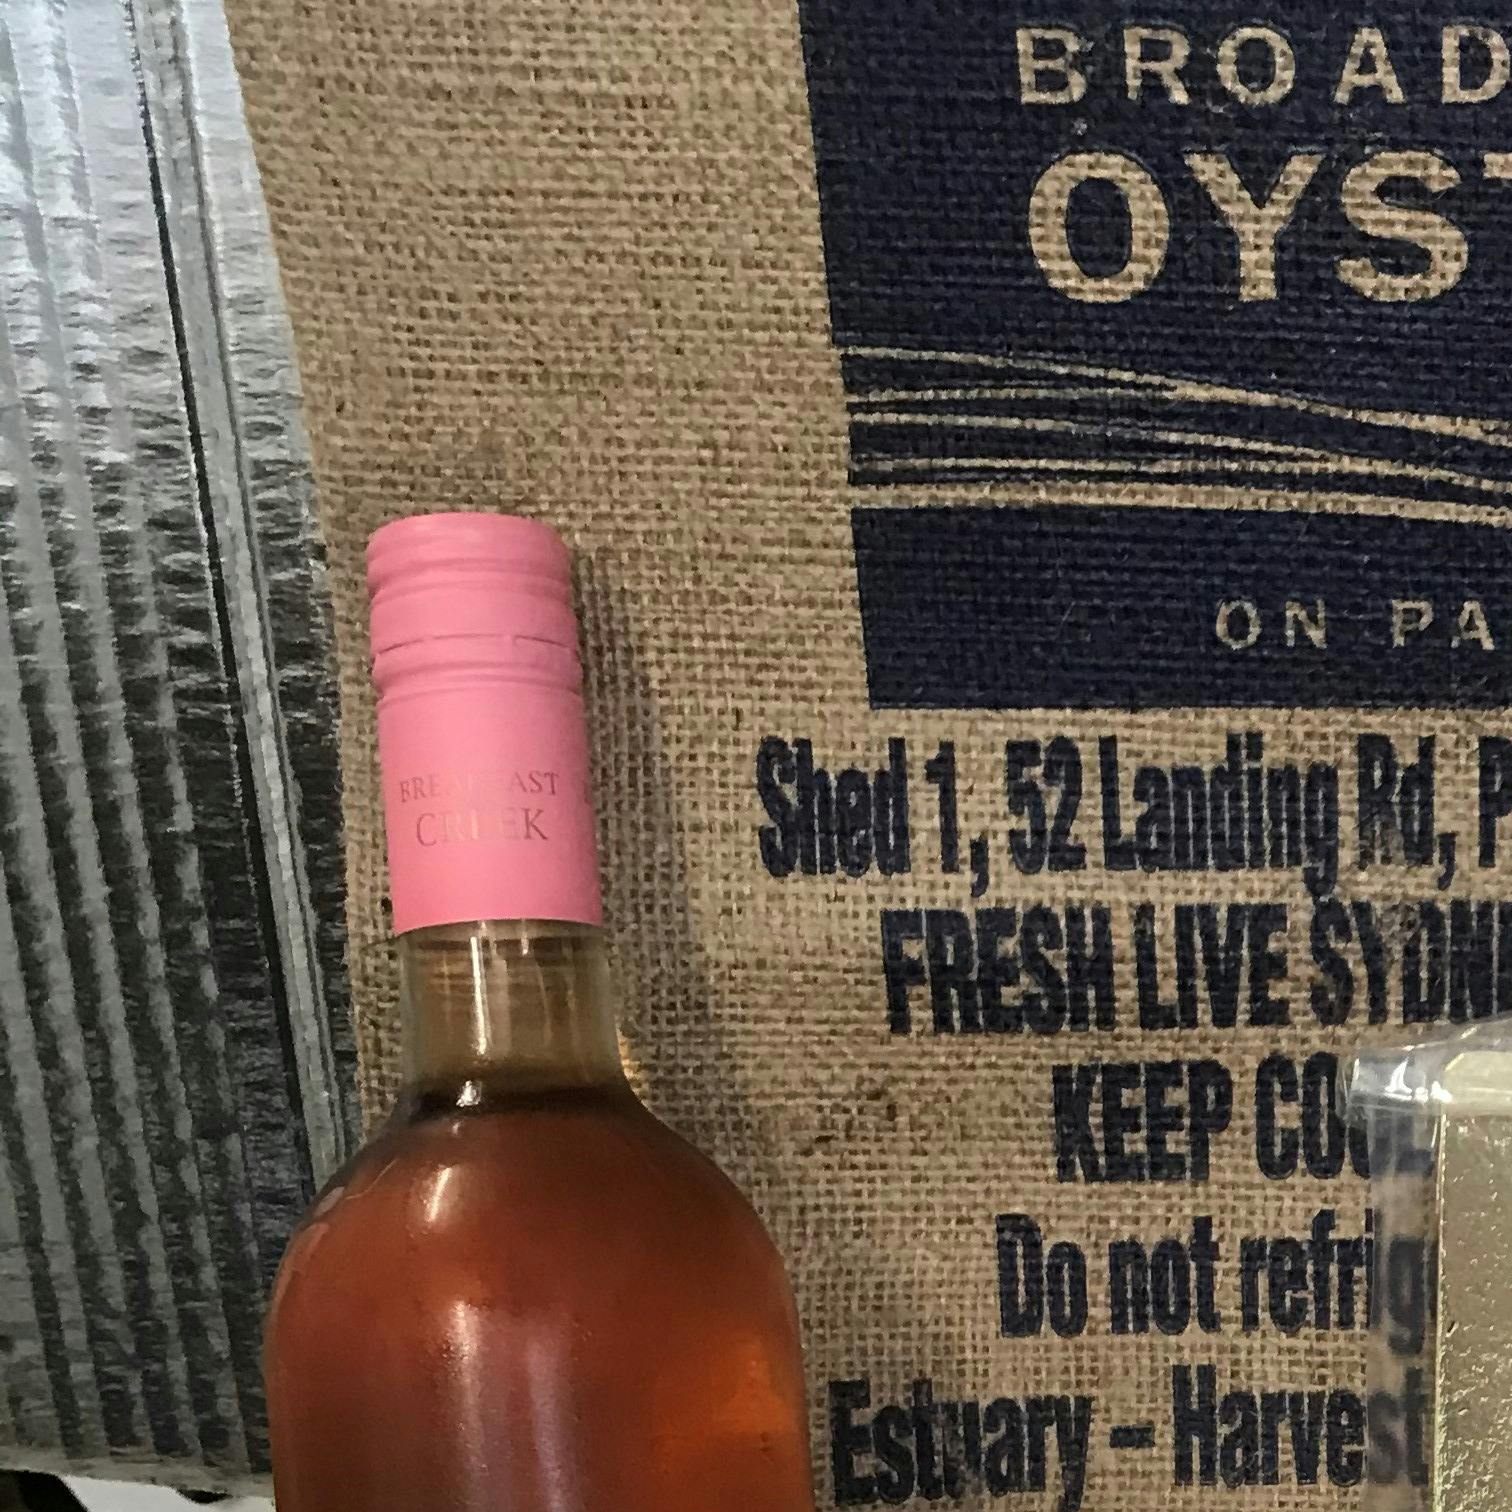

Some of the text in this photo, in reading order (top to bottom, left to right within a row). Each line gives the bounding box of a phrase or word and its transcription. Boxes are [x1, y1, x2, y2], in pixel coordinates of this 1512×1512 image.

[1214, 598, 1333, 652] ON
[757, 735, 911, 878] Shed
[925, 739, 989, 897] 1,
[1005, 735, 1087, 874] 52
[1100, 731, 1340, 899] Landing
[1356, 731, 1458, 892] Rd,
[880, 902, 1117, 1036] FRESH
[1134, 902, 1292, 1031] LIVE
[1052, 1058, 1234, 1184] KEEP
[996, 1207, 1436, 1356] Do not refrig
